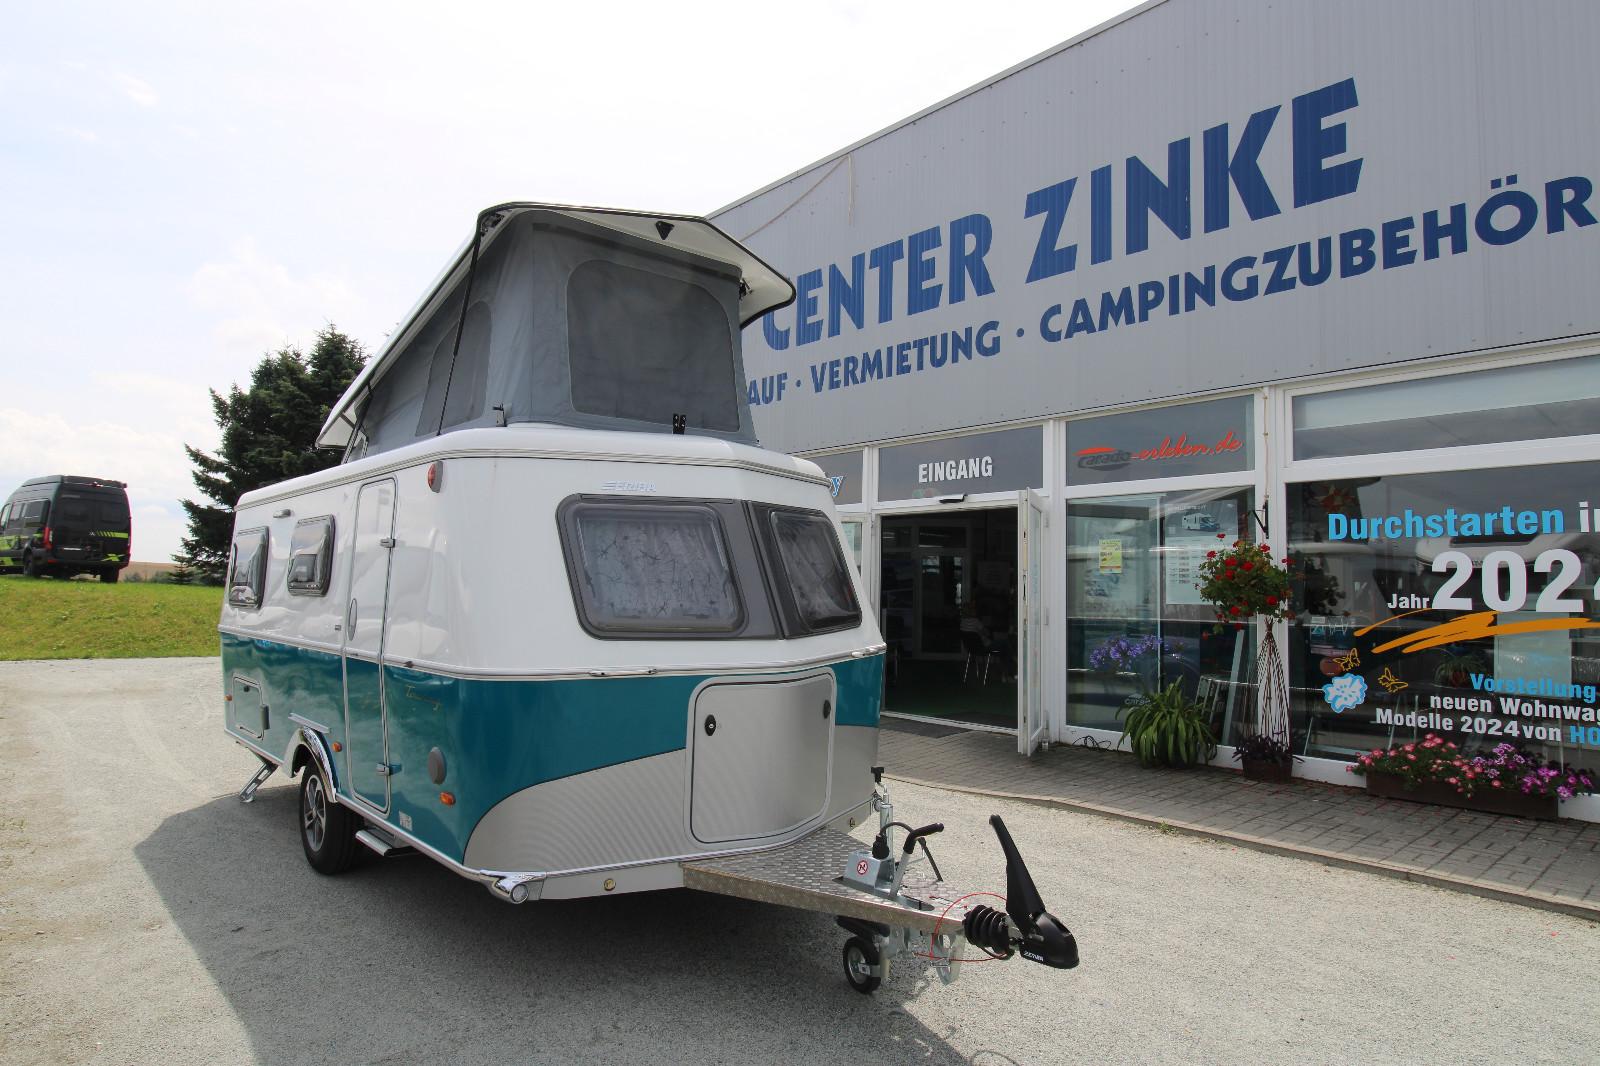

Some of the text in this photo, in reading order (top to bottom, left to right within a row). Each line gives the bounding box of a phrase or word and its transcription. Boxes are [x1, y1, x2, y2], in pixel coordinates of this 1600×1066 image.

[762, 77, 1364, 350] CENTER ZINKE
[809, 320, 1001, 394] VERMIETUNG
[1040, 174, 1599, 342] CAMPINGZUBEHÖR
[918, 455, 993, 483] EINGANG
[1328, 505, 1564, 540] Durchstarten
[1387, 548, 1600, 612] Jahr 202
[1470, 672, 1597, 704] Vorstellung
[1375, 707, 1454, 731] Modelle
[1460, 715, 1520, 737] 2024
[1522, 725, 1561, 742] von
[1430, 695, 1600, 726] neuen Wohnwa
